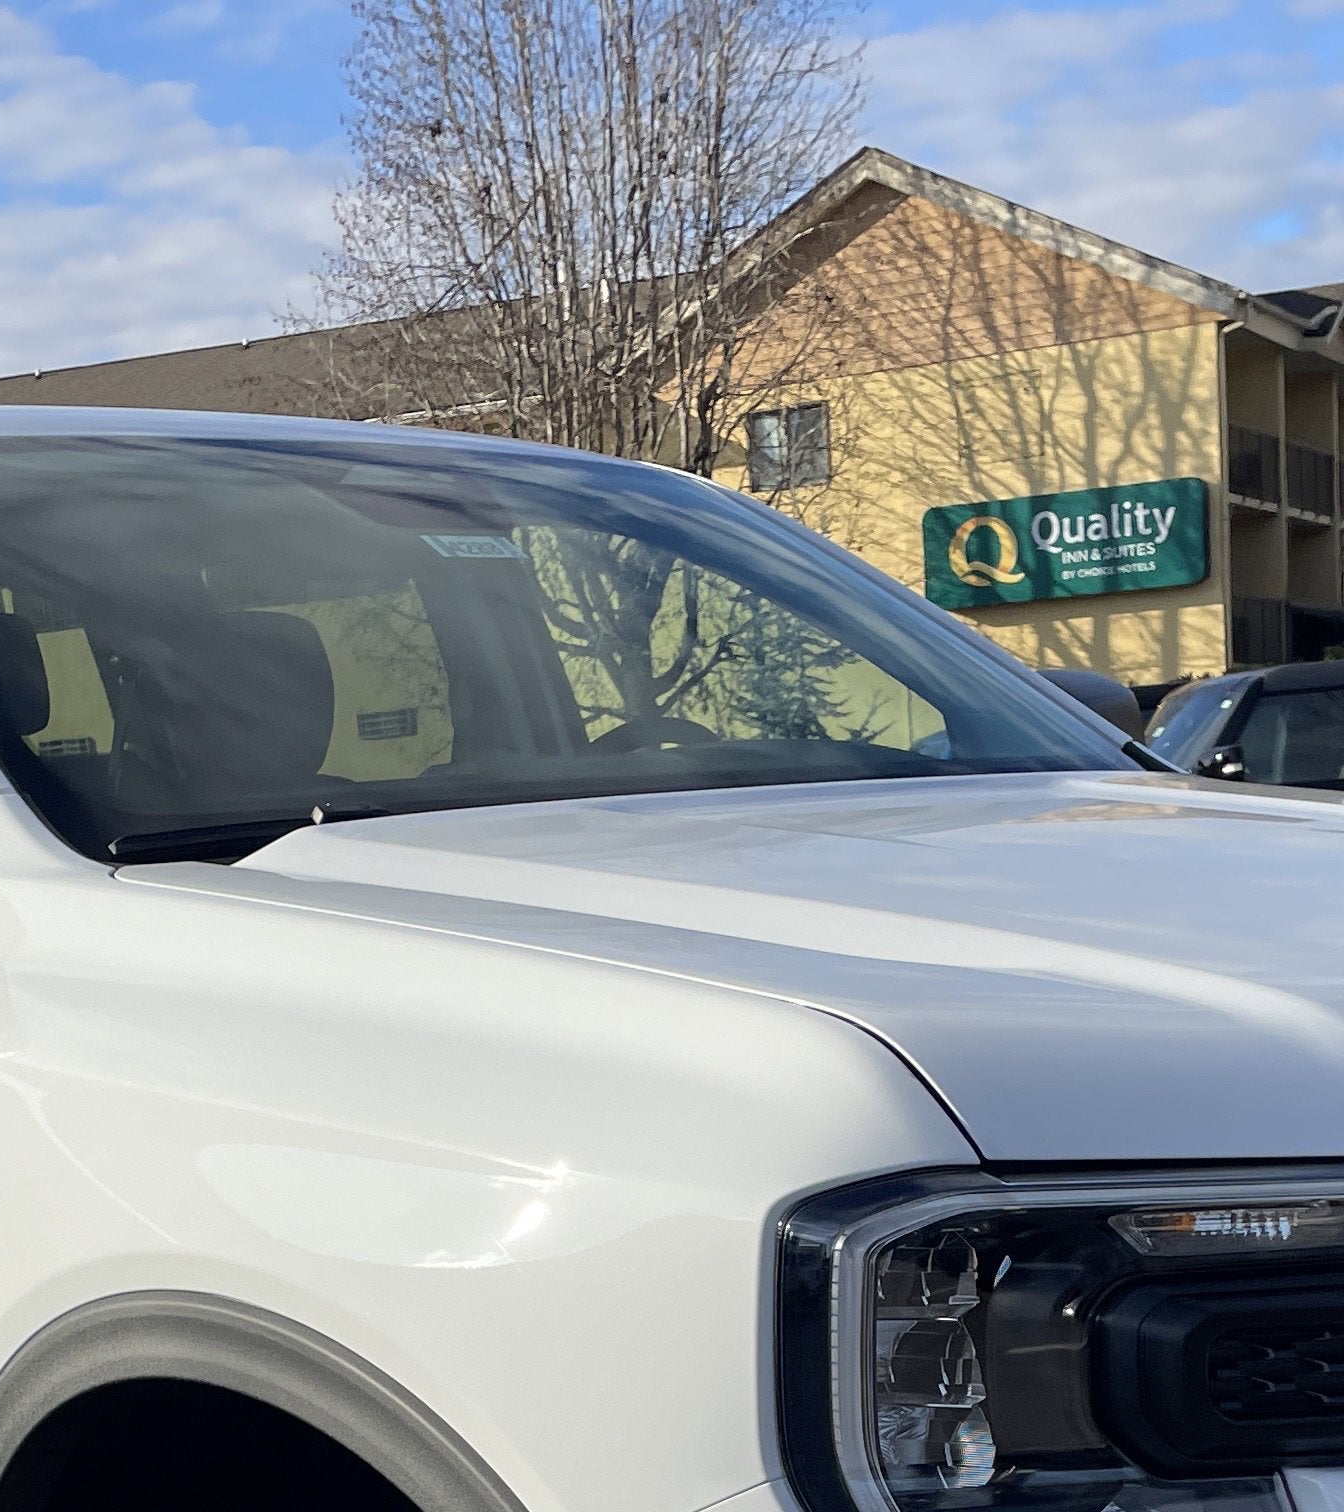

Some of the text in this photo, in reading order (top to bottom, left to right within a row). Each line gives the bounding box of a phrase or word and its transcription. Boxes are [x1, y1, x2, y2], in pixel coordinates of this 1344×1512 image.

[1031, 501, 1176, 554] Quality
[1061, 542, 1156, 565] INN & SUITES
[1061, 561, 1156, 580] BY CHOICE HOTELS
